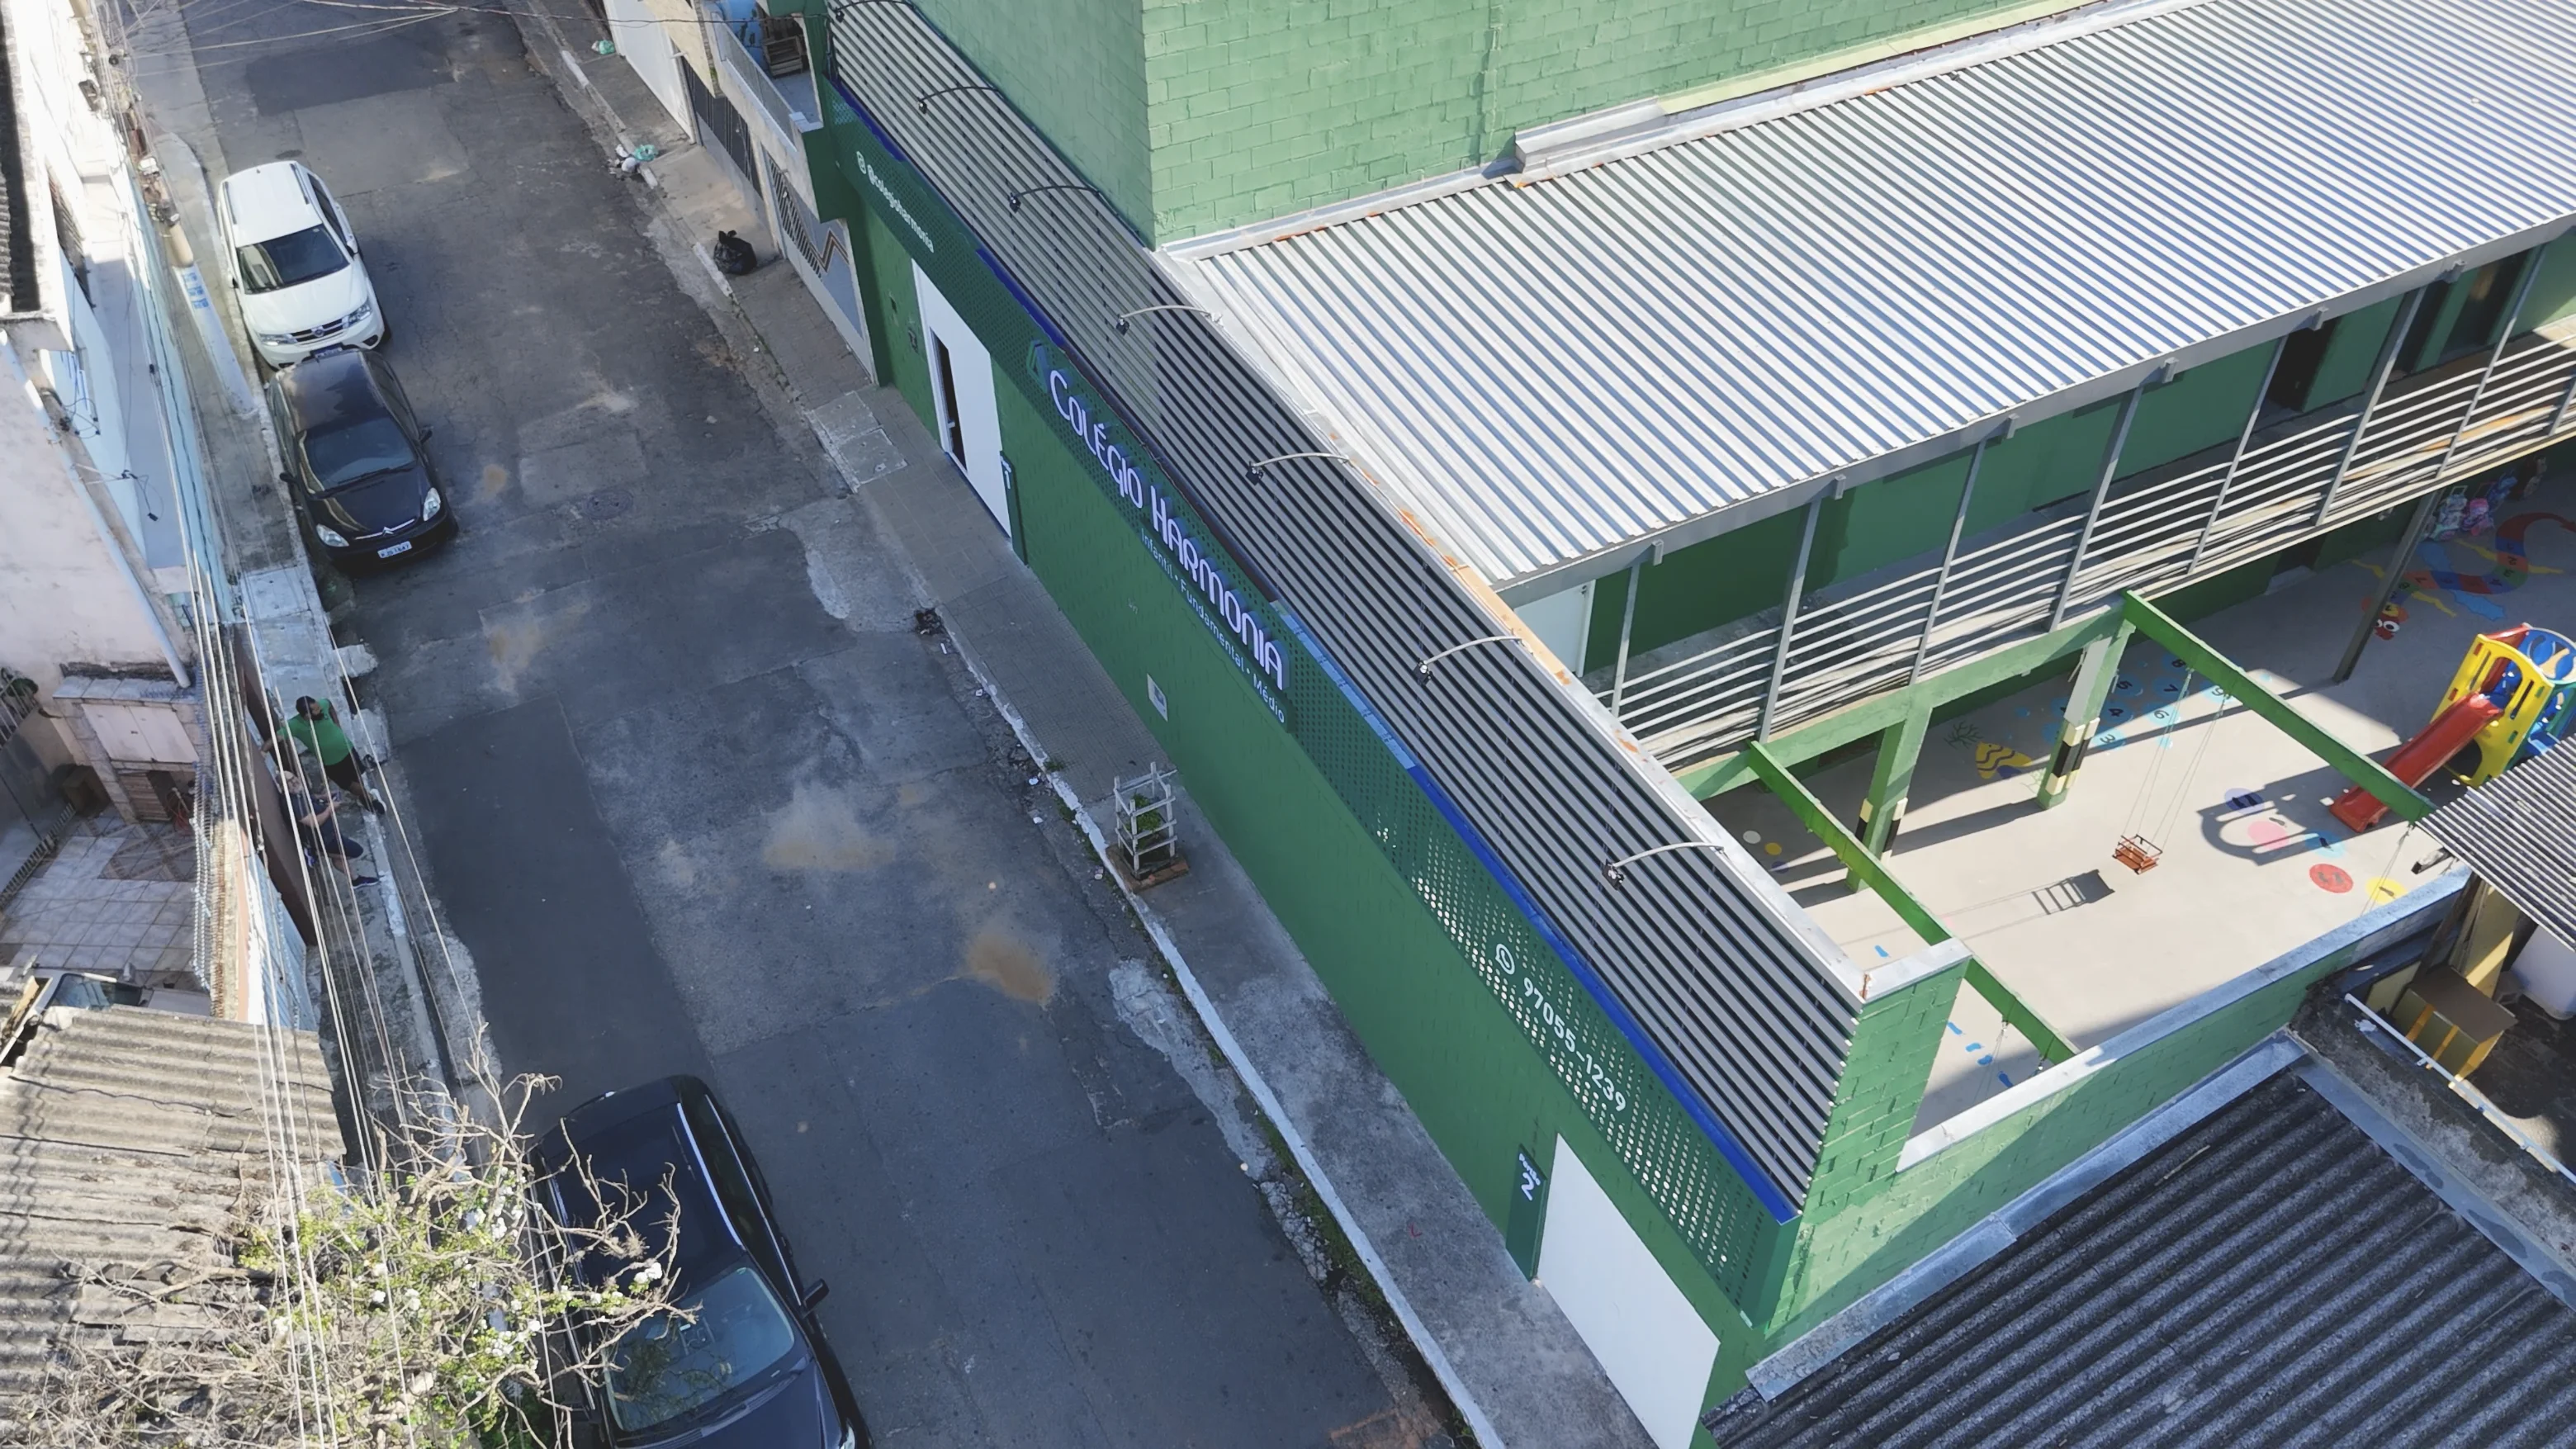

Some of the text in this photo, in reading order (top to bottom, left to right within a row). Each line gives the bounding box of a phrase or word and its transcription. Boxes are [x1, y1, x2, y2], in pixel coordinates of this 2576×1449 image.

[1140, 528, 1285, 724] Infantil Fundamental Médio
[1523, 977, 1627, 1111] 97055-1239
[1521, 1172, 1535, 1200] 2
